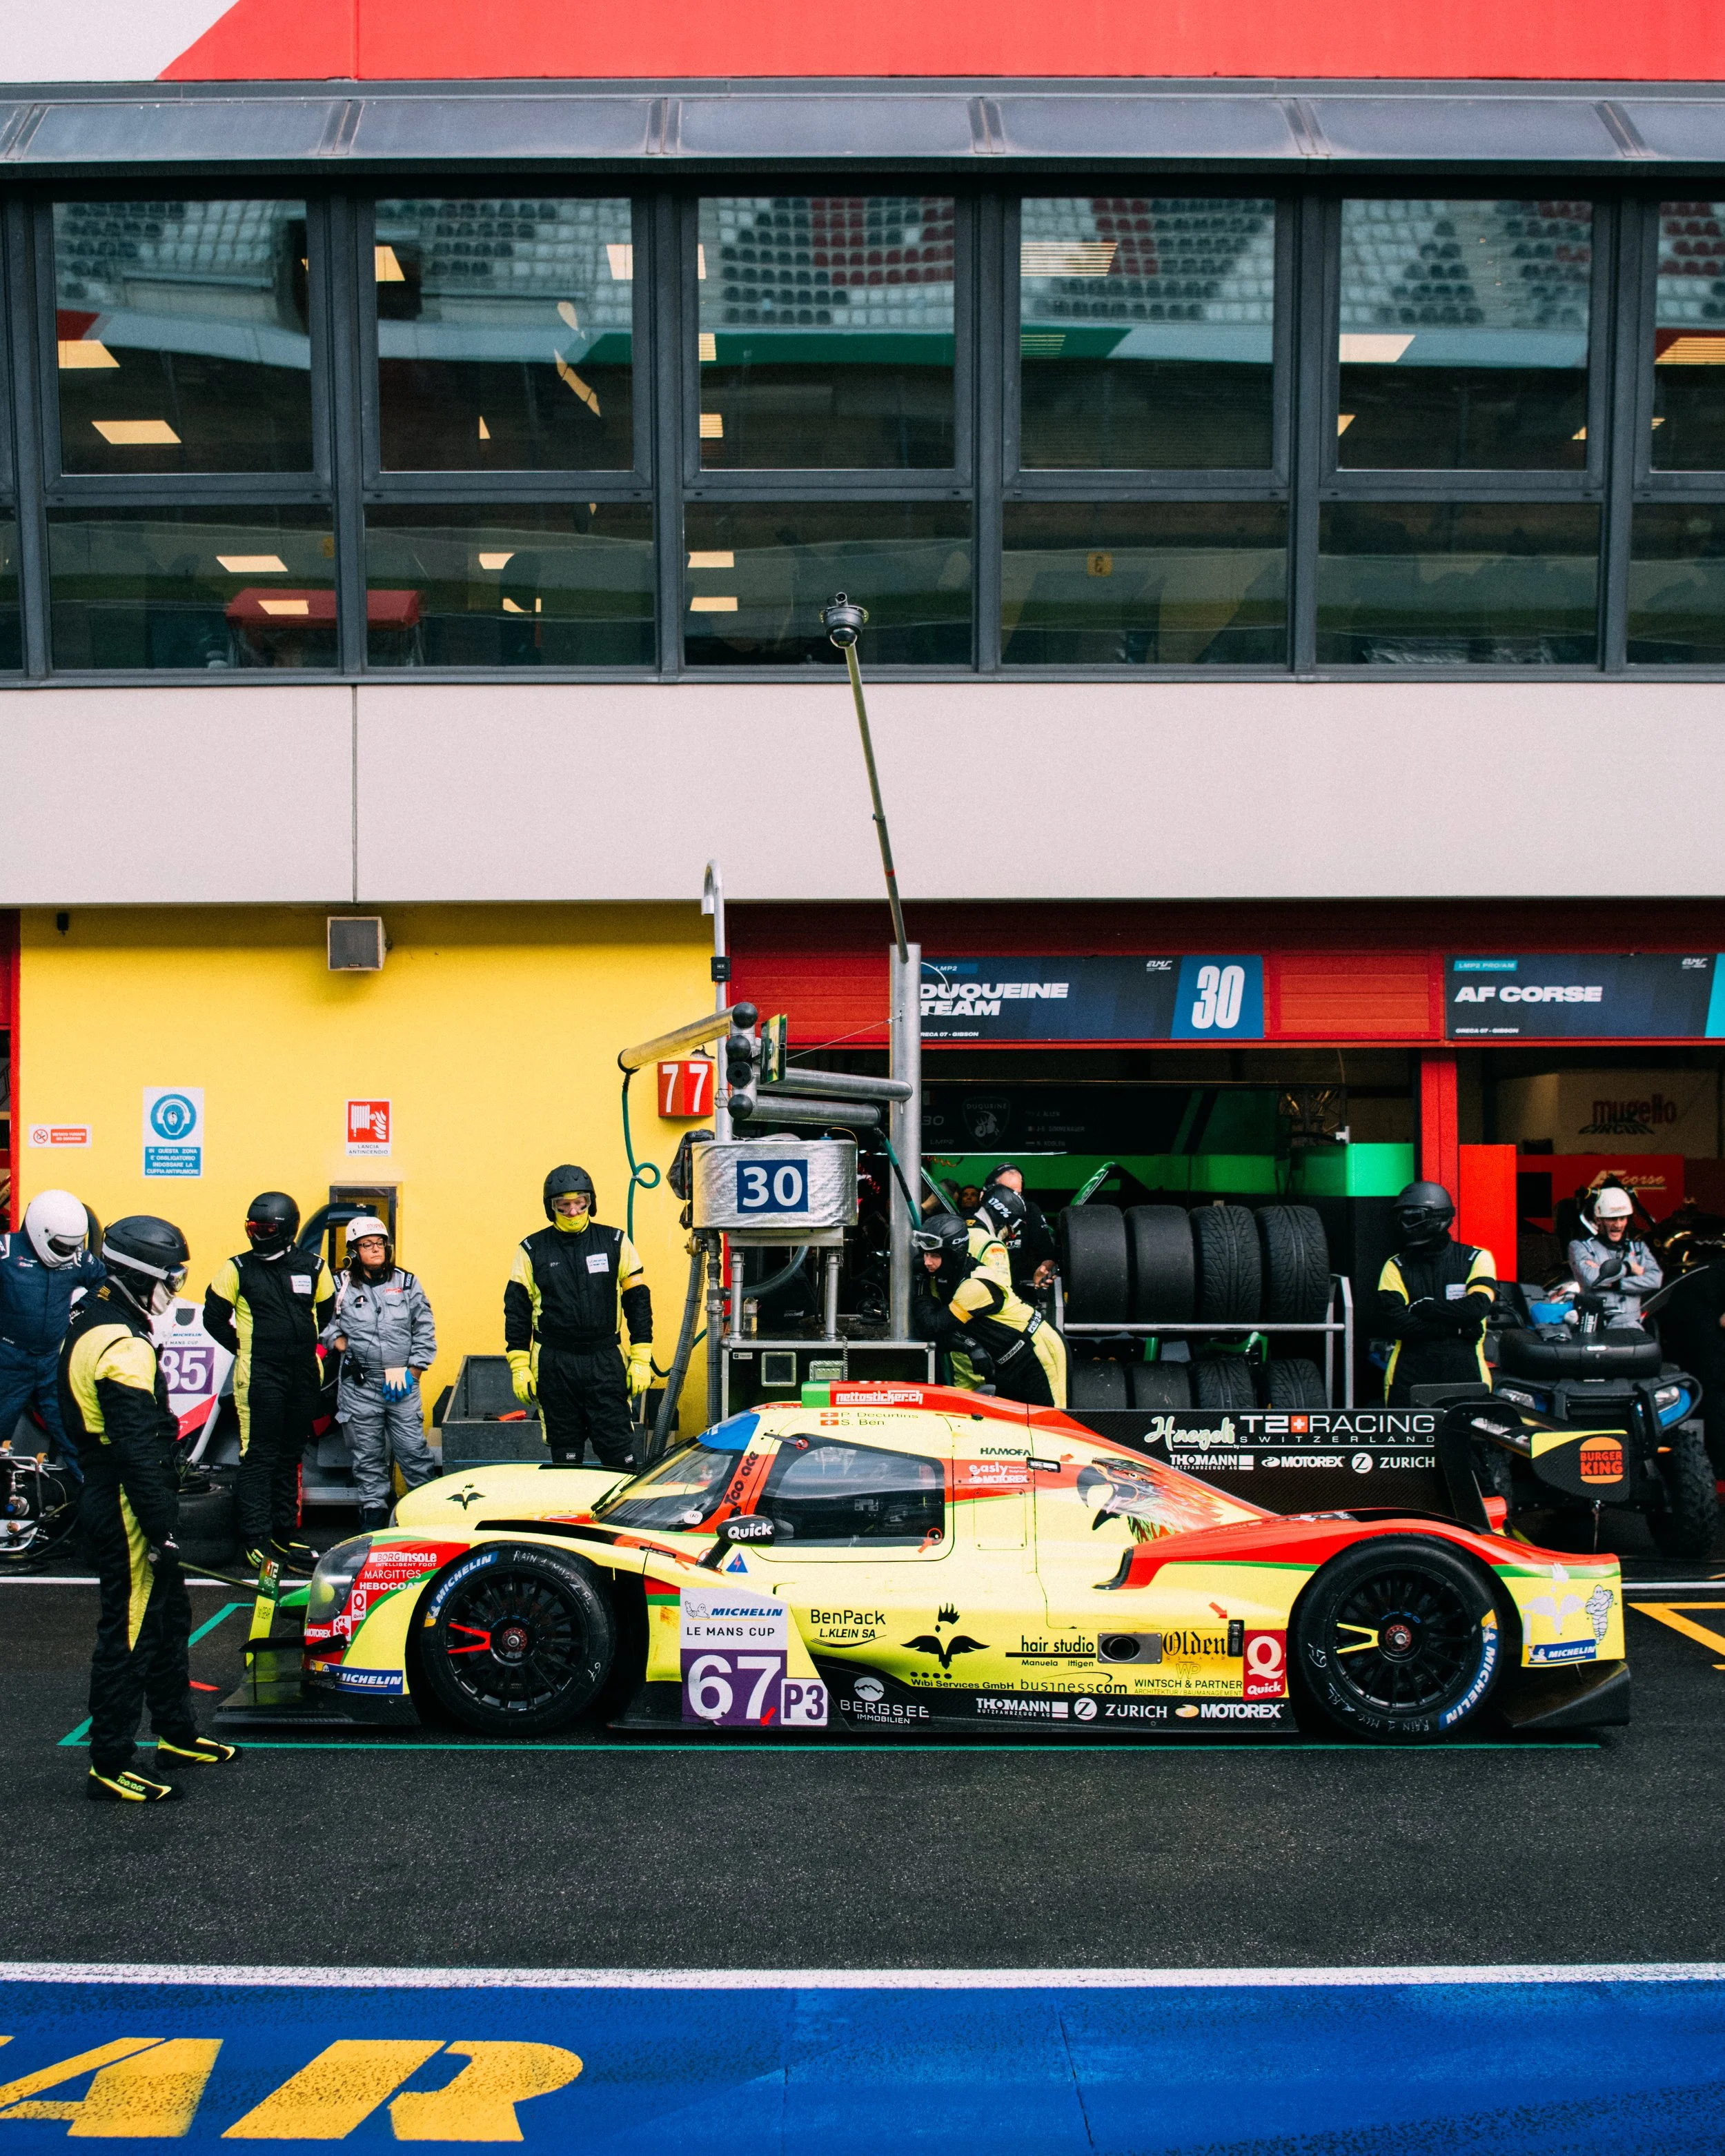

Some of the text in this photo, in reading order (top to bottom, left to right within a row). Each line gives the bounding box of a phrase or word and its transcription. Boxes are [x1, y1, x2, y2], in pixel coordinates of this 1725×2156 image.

[920, 982, 1069, 1001] DUQUEINE
[1191, 965, 1245, 1029] 30
[1454, 986, 1603, 1002] AF CORSE
[920, 1000, 1001, 1016] TEAM
[1593, 1094, 1677, 1125] mugello
[921, 1115, 945, 1126] 30
[742, 1165, 802, 1207] 30
[164, 1349, 207, 1391] 85
[836, 1389, 923, 1405] nettosticker.ch
[1240, 1415, 1435, 1433] T2 RACING
[1144, 1416, 1235, 1452] Haegeli
[980, 1447, 1032, 1456] HAMOFA
[1170, 1454, 1238, 1465] THOMANN
[1580, 1451, 1622, 1461] BURGER
[1281, 1456, 1344, 1468] MOTOREX
[1379, 1456, 1435, 1468] ZURICH
[1581, 1461, 1623, 1475] KING
[724, 1450, 760, 1507] Tooace
[983, 1475, 1028, 1483] MOTOREX
[727, 1523, 773, 1540] Quick
[270, 1561, 279, 1579] T2
[359, 1582, 421, 1590] HEBOCOAT
[436, 1554, 493, 1603] MICHELIN
[353, 1593, 364, 1611] Q
[711, 1608, 783, 1616] MICHELIN
[811, 1609, 886, 1625] BenPack
[305, 1628, 331, 1638] MOTOREX
[687, 1627, 775, 1636] LE MANS CUP
[819, 1628, 876, 1638] L.KLEIN SA
[1021, 1634, 1094, 1652] hair studio
[1163, 1630, 1226, 1656] Olden
[1246, 1635, 1284, 1679] Q
[1548, 1645, 1595, 1659] MICHELIN
[1067, 1660, 1094, 1668] Ittigen
[339, 1672, 402, 1685] MICHELIN
[911, 1678, 1014, 1690] Wibi Services GmbH
[1134, 1679, 1243, 1689] WINTSCH & PARTNER
[1445, 1645, 1496, 1725] MICHELIN
[687, 1654, 781, 1720] 67
[1247, 1681, 1282, 1695] Quick
[784, 1683, 825, 1720] P3
[840, 1699, 929, 1718] BERGSEE
[976, 1697, 1050, 1712] THOMANN
[857, 1713, 910, 1724] IMMOBILIEN
[978, 1708, 1037, 1717] NUTZFAHRZEUGE
[1105, 1704, 1167, 1718] ZURICH
[1201, 1703, 1281, 1719] MOTOREX
[0, 2037, 584, 2142] AR
